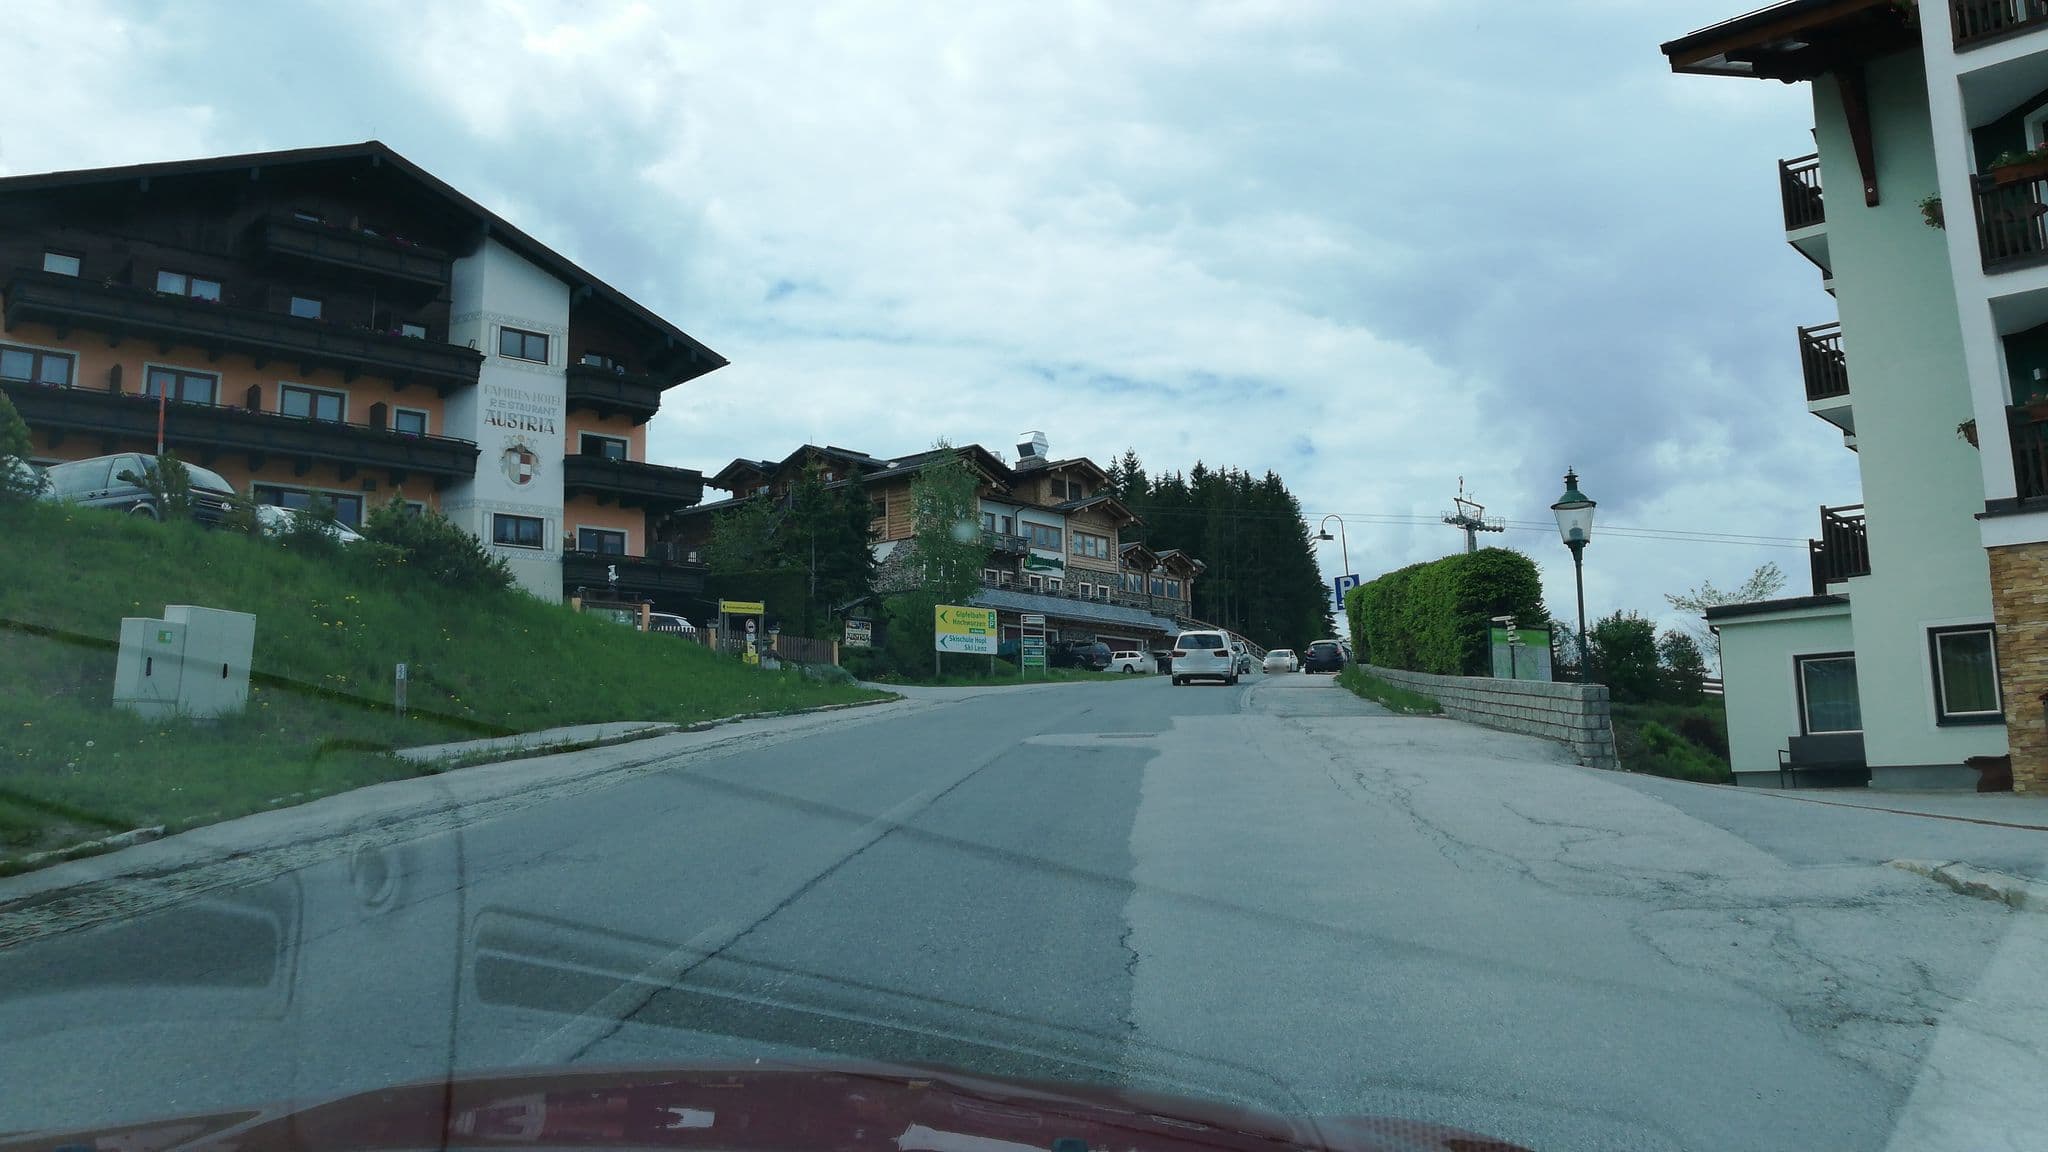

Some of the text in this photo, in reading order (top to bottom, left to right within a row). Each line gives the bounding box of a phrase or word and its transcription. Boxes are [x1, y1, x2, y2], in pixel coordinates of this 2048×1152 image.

[489, 398, 558, 416] RESTAURANT
[484, 408, 555, 435] AUSTRIA
[1339, 576, 1355, 599] P
